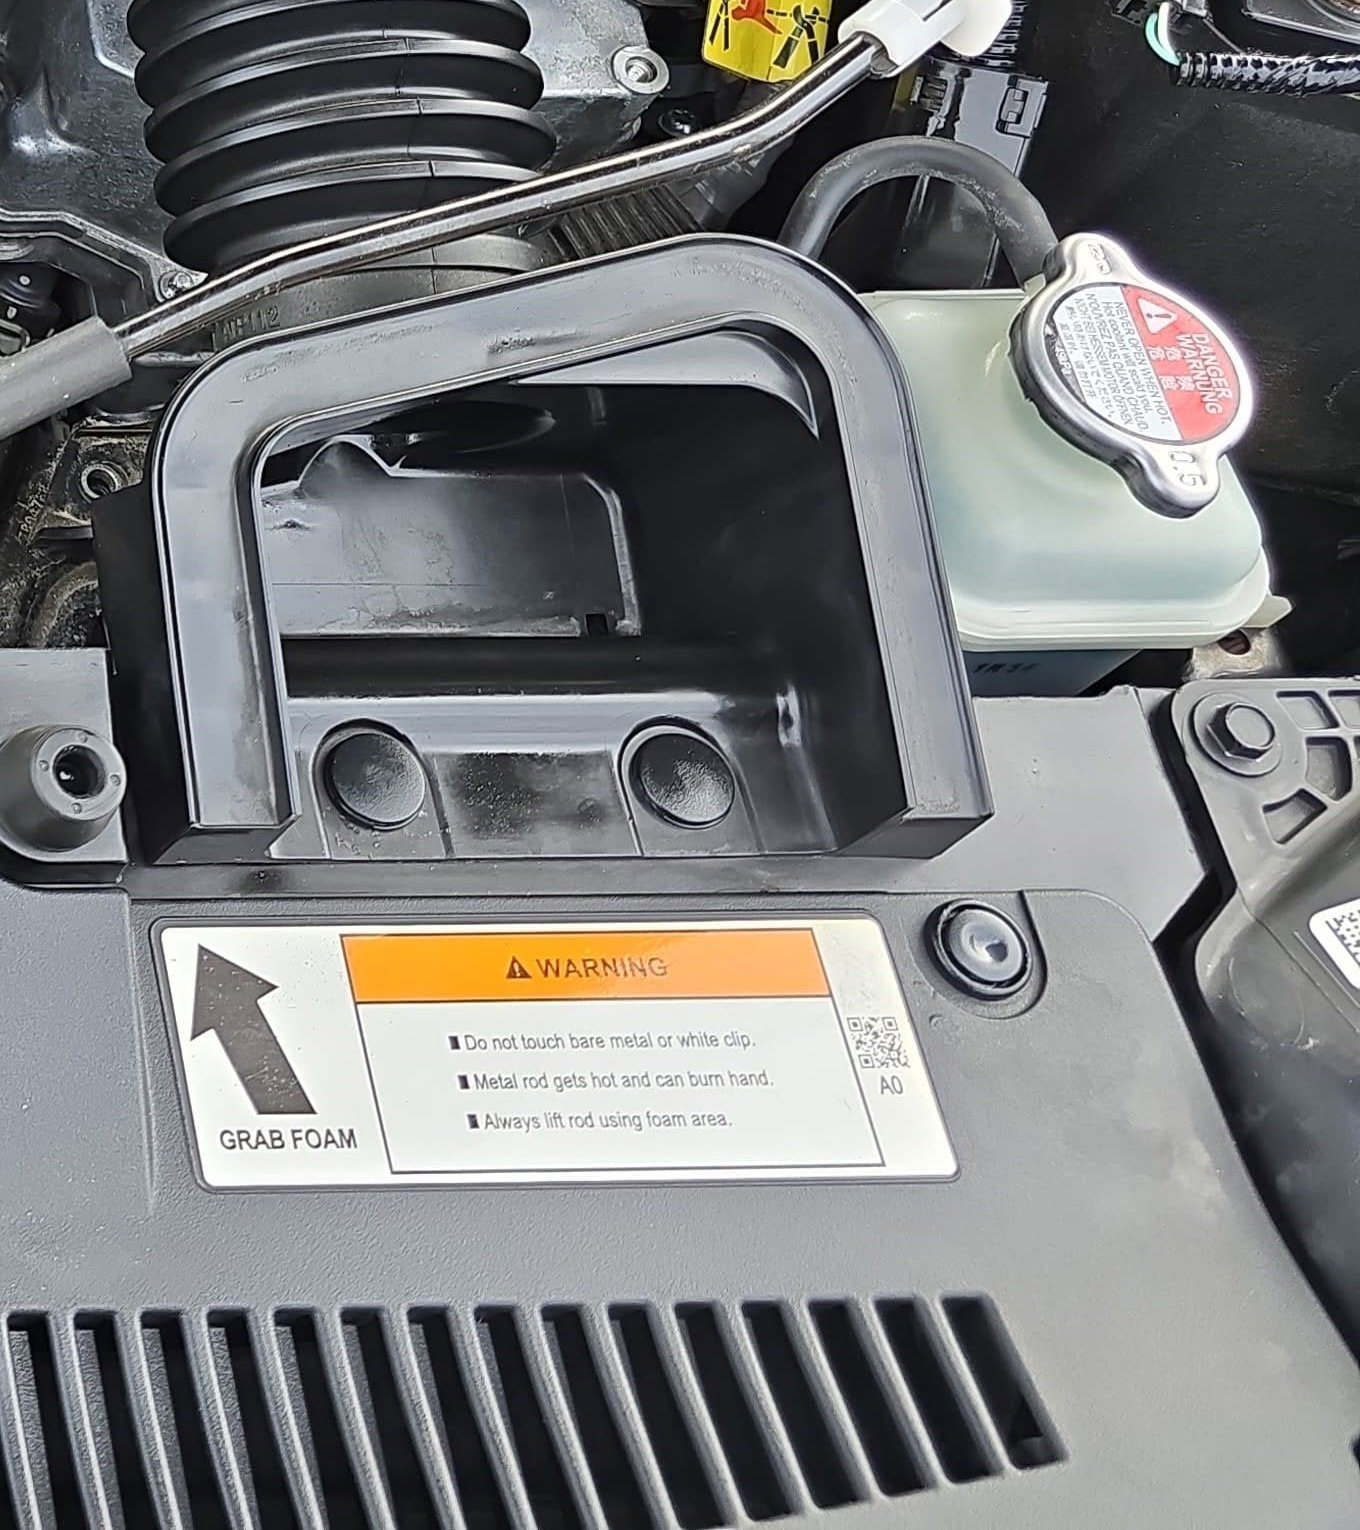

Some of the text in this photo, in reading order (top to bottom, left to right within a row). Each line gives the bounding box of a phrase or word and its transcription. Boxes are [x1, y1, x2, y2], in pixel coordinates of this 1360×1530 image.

[1100, 301, 1116, 318] Hot
[1107, 318, 1130, 351] coolant
[1104, 340, 1121, 360] PAS
[1112, 302, 1172, 423] NEVER OPEN WHEN HOT.
[1191, 331, 1234, 400] DANGER
[1112, 361, 1135, 395] QUAND
[1175, 334, 1223, 415] WARNUNG
[536, 956, 668, 980] WARNING
[465, 1030, 756, 1052] Do not touch bare metal or white clip.
[474, 1070, 774, 1092] Metal rod gets hot and can burn hand.
[484, 1110, 733, 1132] Always lift rod using foam area.
[219, 1128, 359, 1151] GRAB FOAM
